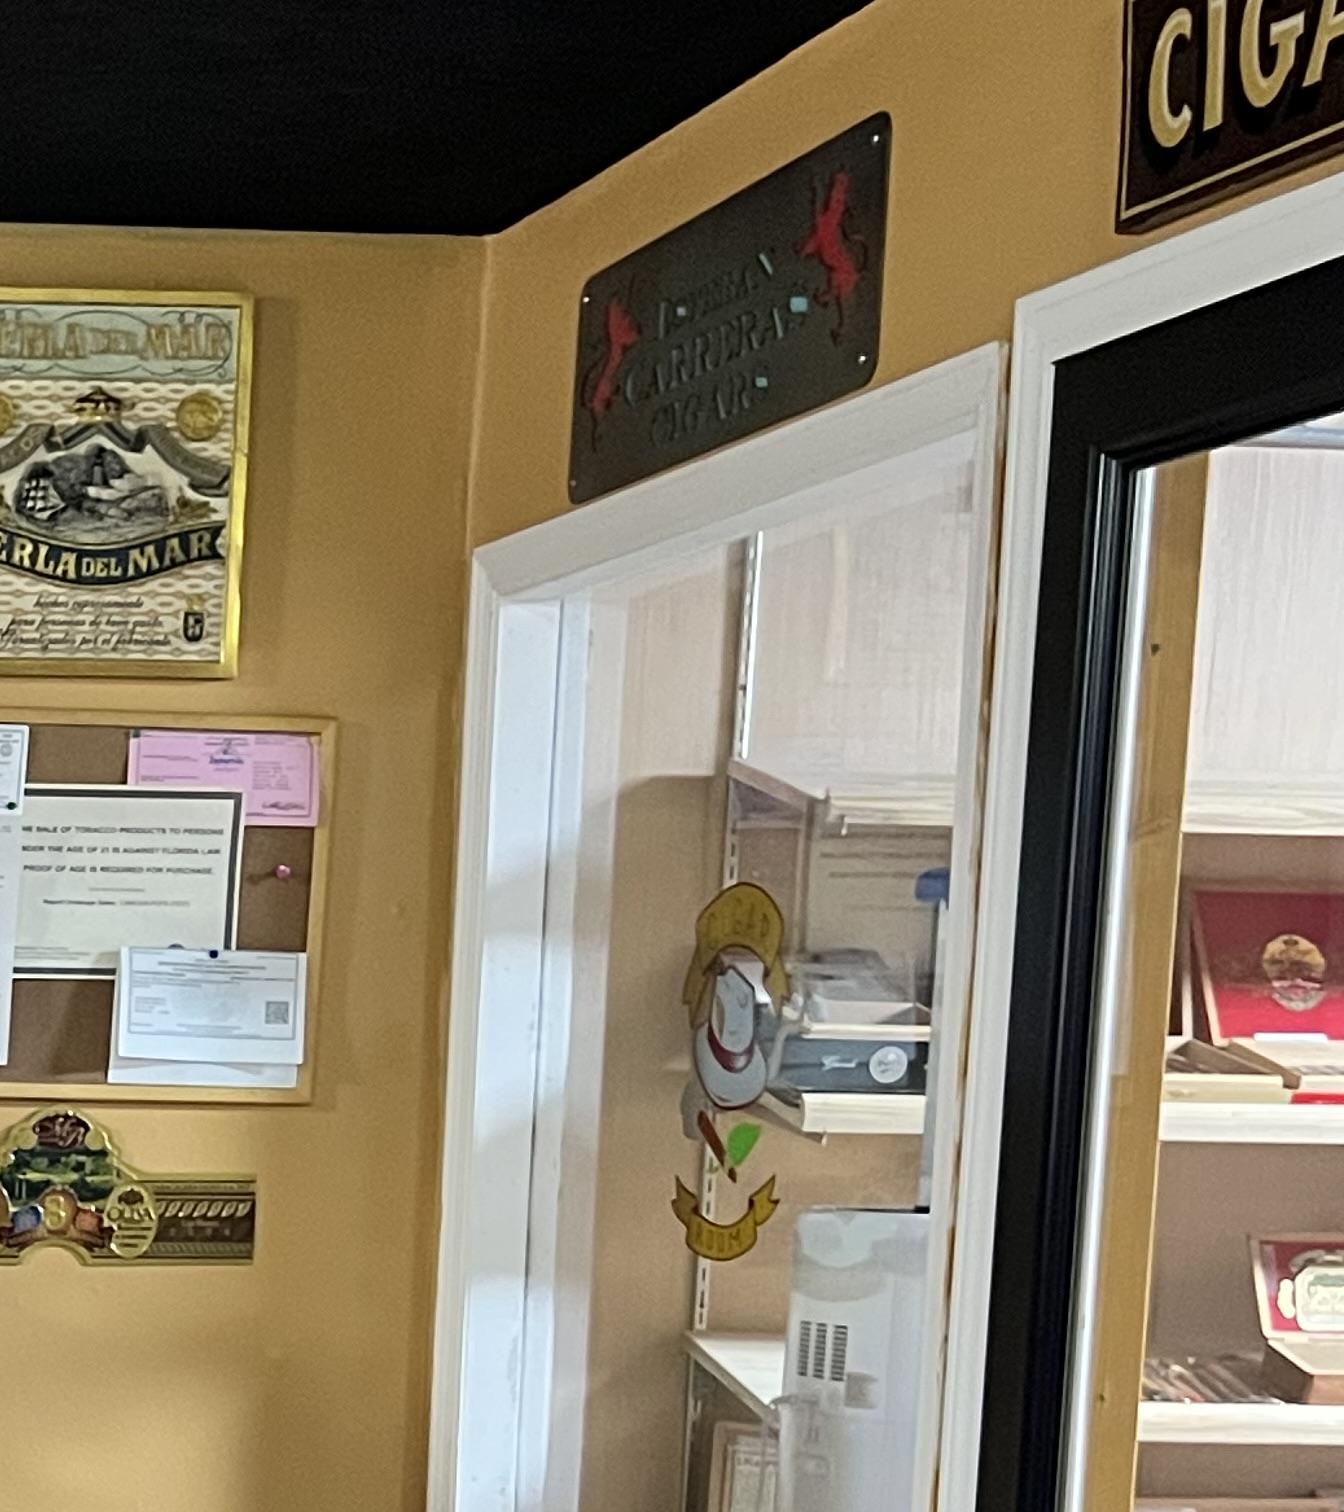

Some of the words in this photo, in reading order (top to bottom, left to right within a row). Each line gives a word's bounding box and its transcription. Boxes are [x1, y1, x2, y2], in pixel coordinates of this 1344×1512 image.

[137, 322, 227, 360] MAR
[81, 556, 123, 578] DEL
[127, 530, 214, 577] MAR
